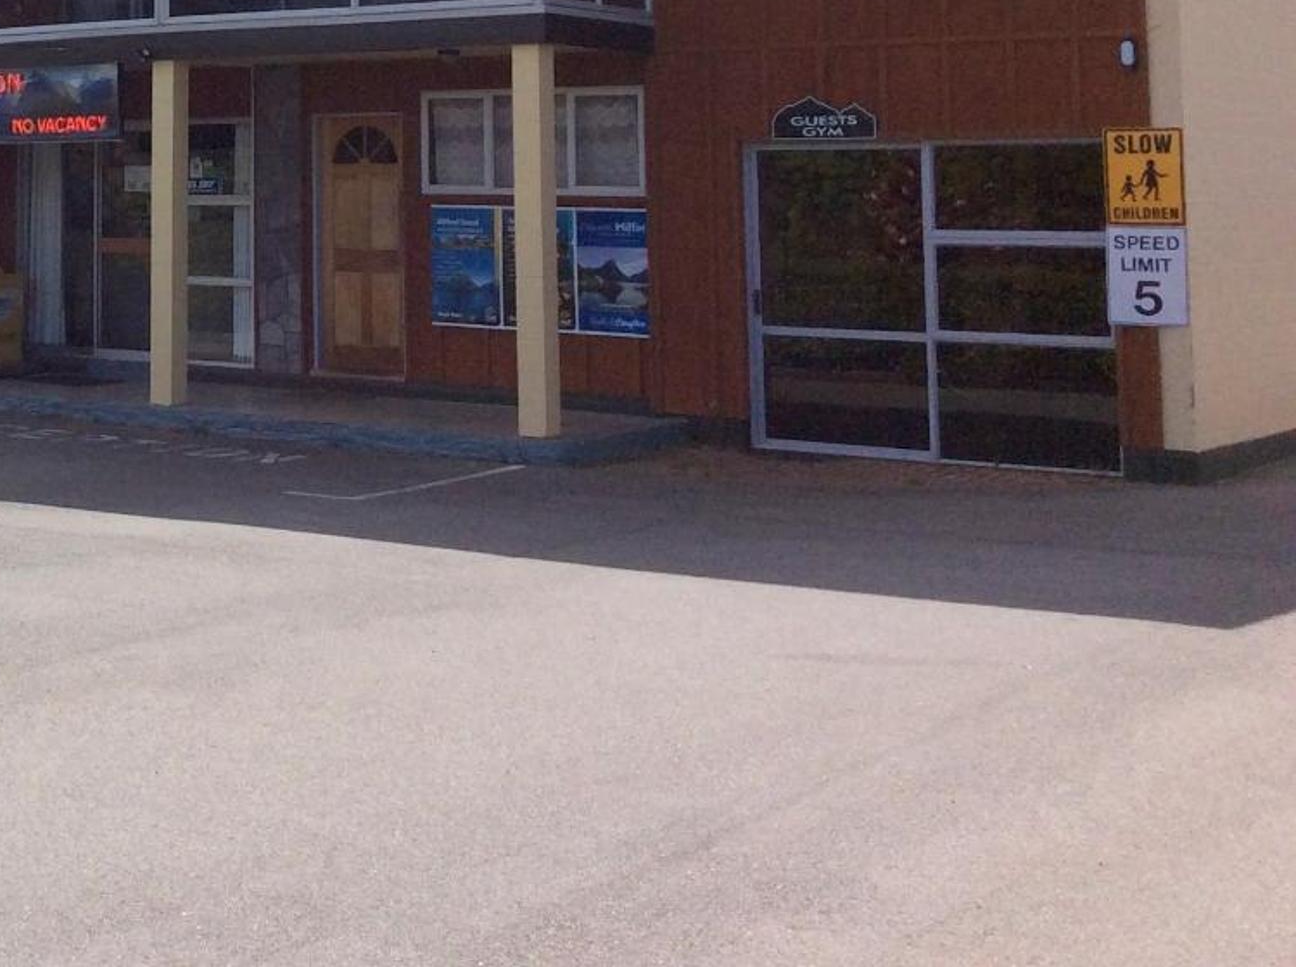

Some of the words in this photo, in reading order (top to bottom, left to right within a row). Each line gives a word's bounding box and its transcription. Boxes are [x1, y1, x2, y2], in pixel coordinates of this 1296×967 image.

[11, 117, 35, 135] NO
[37, 115, 107, 134] VACANCY
[790, 114, 858, 127] GUESTS
[802, 127, 844, 137] GYM
[1113, 134, 1173, 154] SLOW
[1113, 206, 1180, 220] CHILDREN
[1113, 235, 1180, 250] SPEED
[1120, 256, 1173, 273] LIMIT
[1133, 279, 1164, 317] 5
